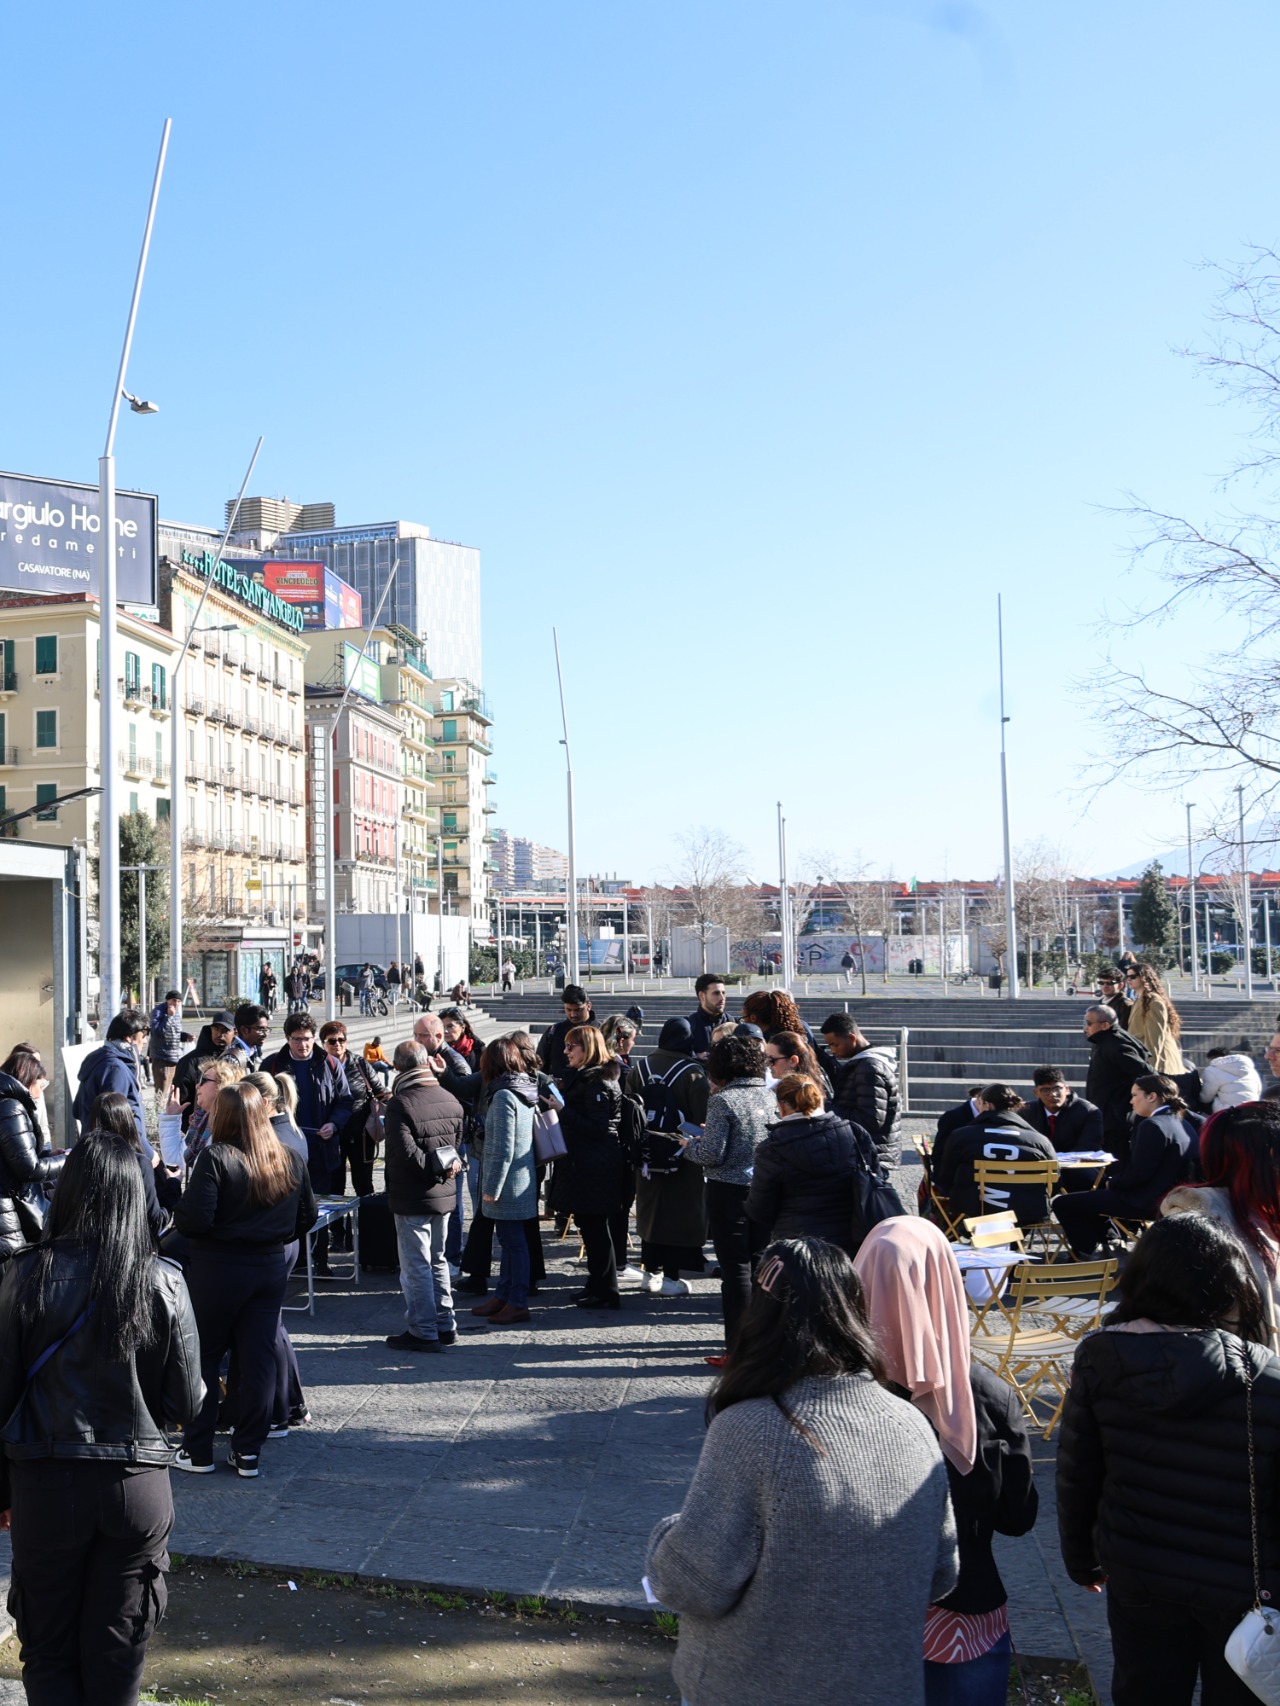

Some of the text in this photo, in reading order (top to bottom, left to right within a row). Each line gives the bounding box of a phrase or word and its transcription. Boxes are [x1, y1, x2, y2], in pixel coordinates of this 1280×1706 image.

[18, 562, 91, 581] CASAVATORE (NA)
[204, 550, 304, 632] HOTEL SANT'ANGELO
[314, 727, 325, 780] HOTEL
[977, 1127, 1020, 1209] ICN
